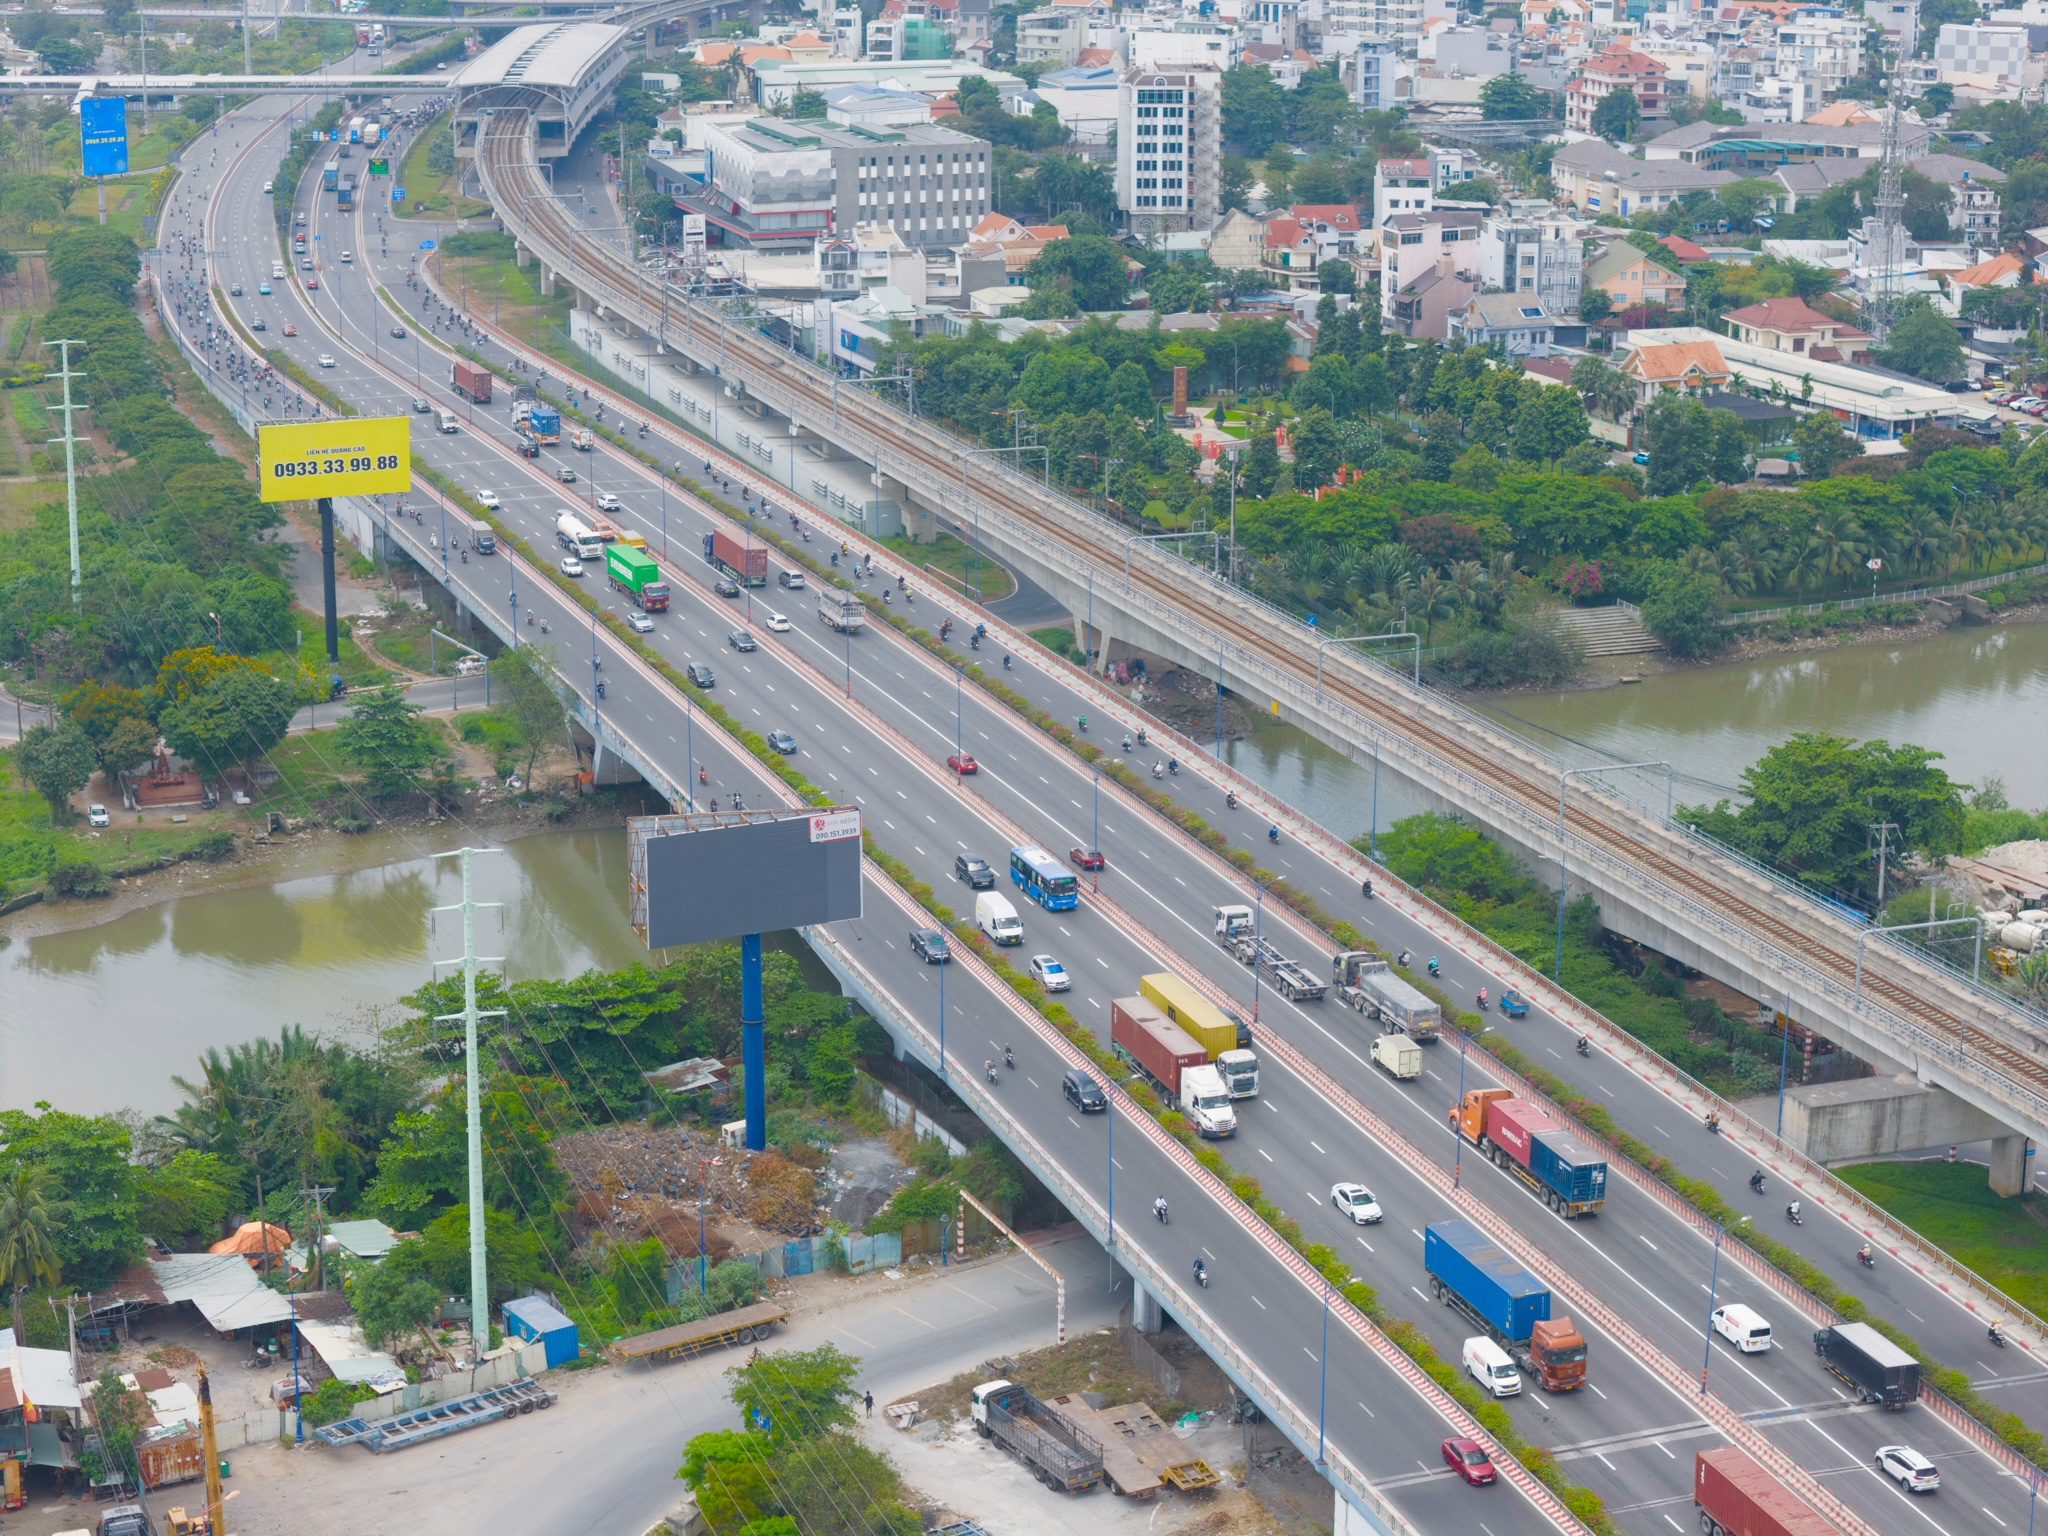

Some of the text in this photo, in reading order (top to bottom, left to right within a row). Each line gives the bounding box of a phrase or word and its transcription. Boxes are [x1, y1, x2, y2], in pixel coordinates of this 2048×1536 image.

[306, 448, 320, 456] LIÊN
[321, 447, 330, 455] HỆ
[331, 446, 352, 454] QUẢNG
[274, 455, 399, 478] 0933.33.99.88
[840, 817, 857, 825] MEDIA
[815, 827, 857, 840] 090.151.3939
